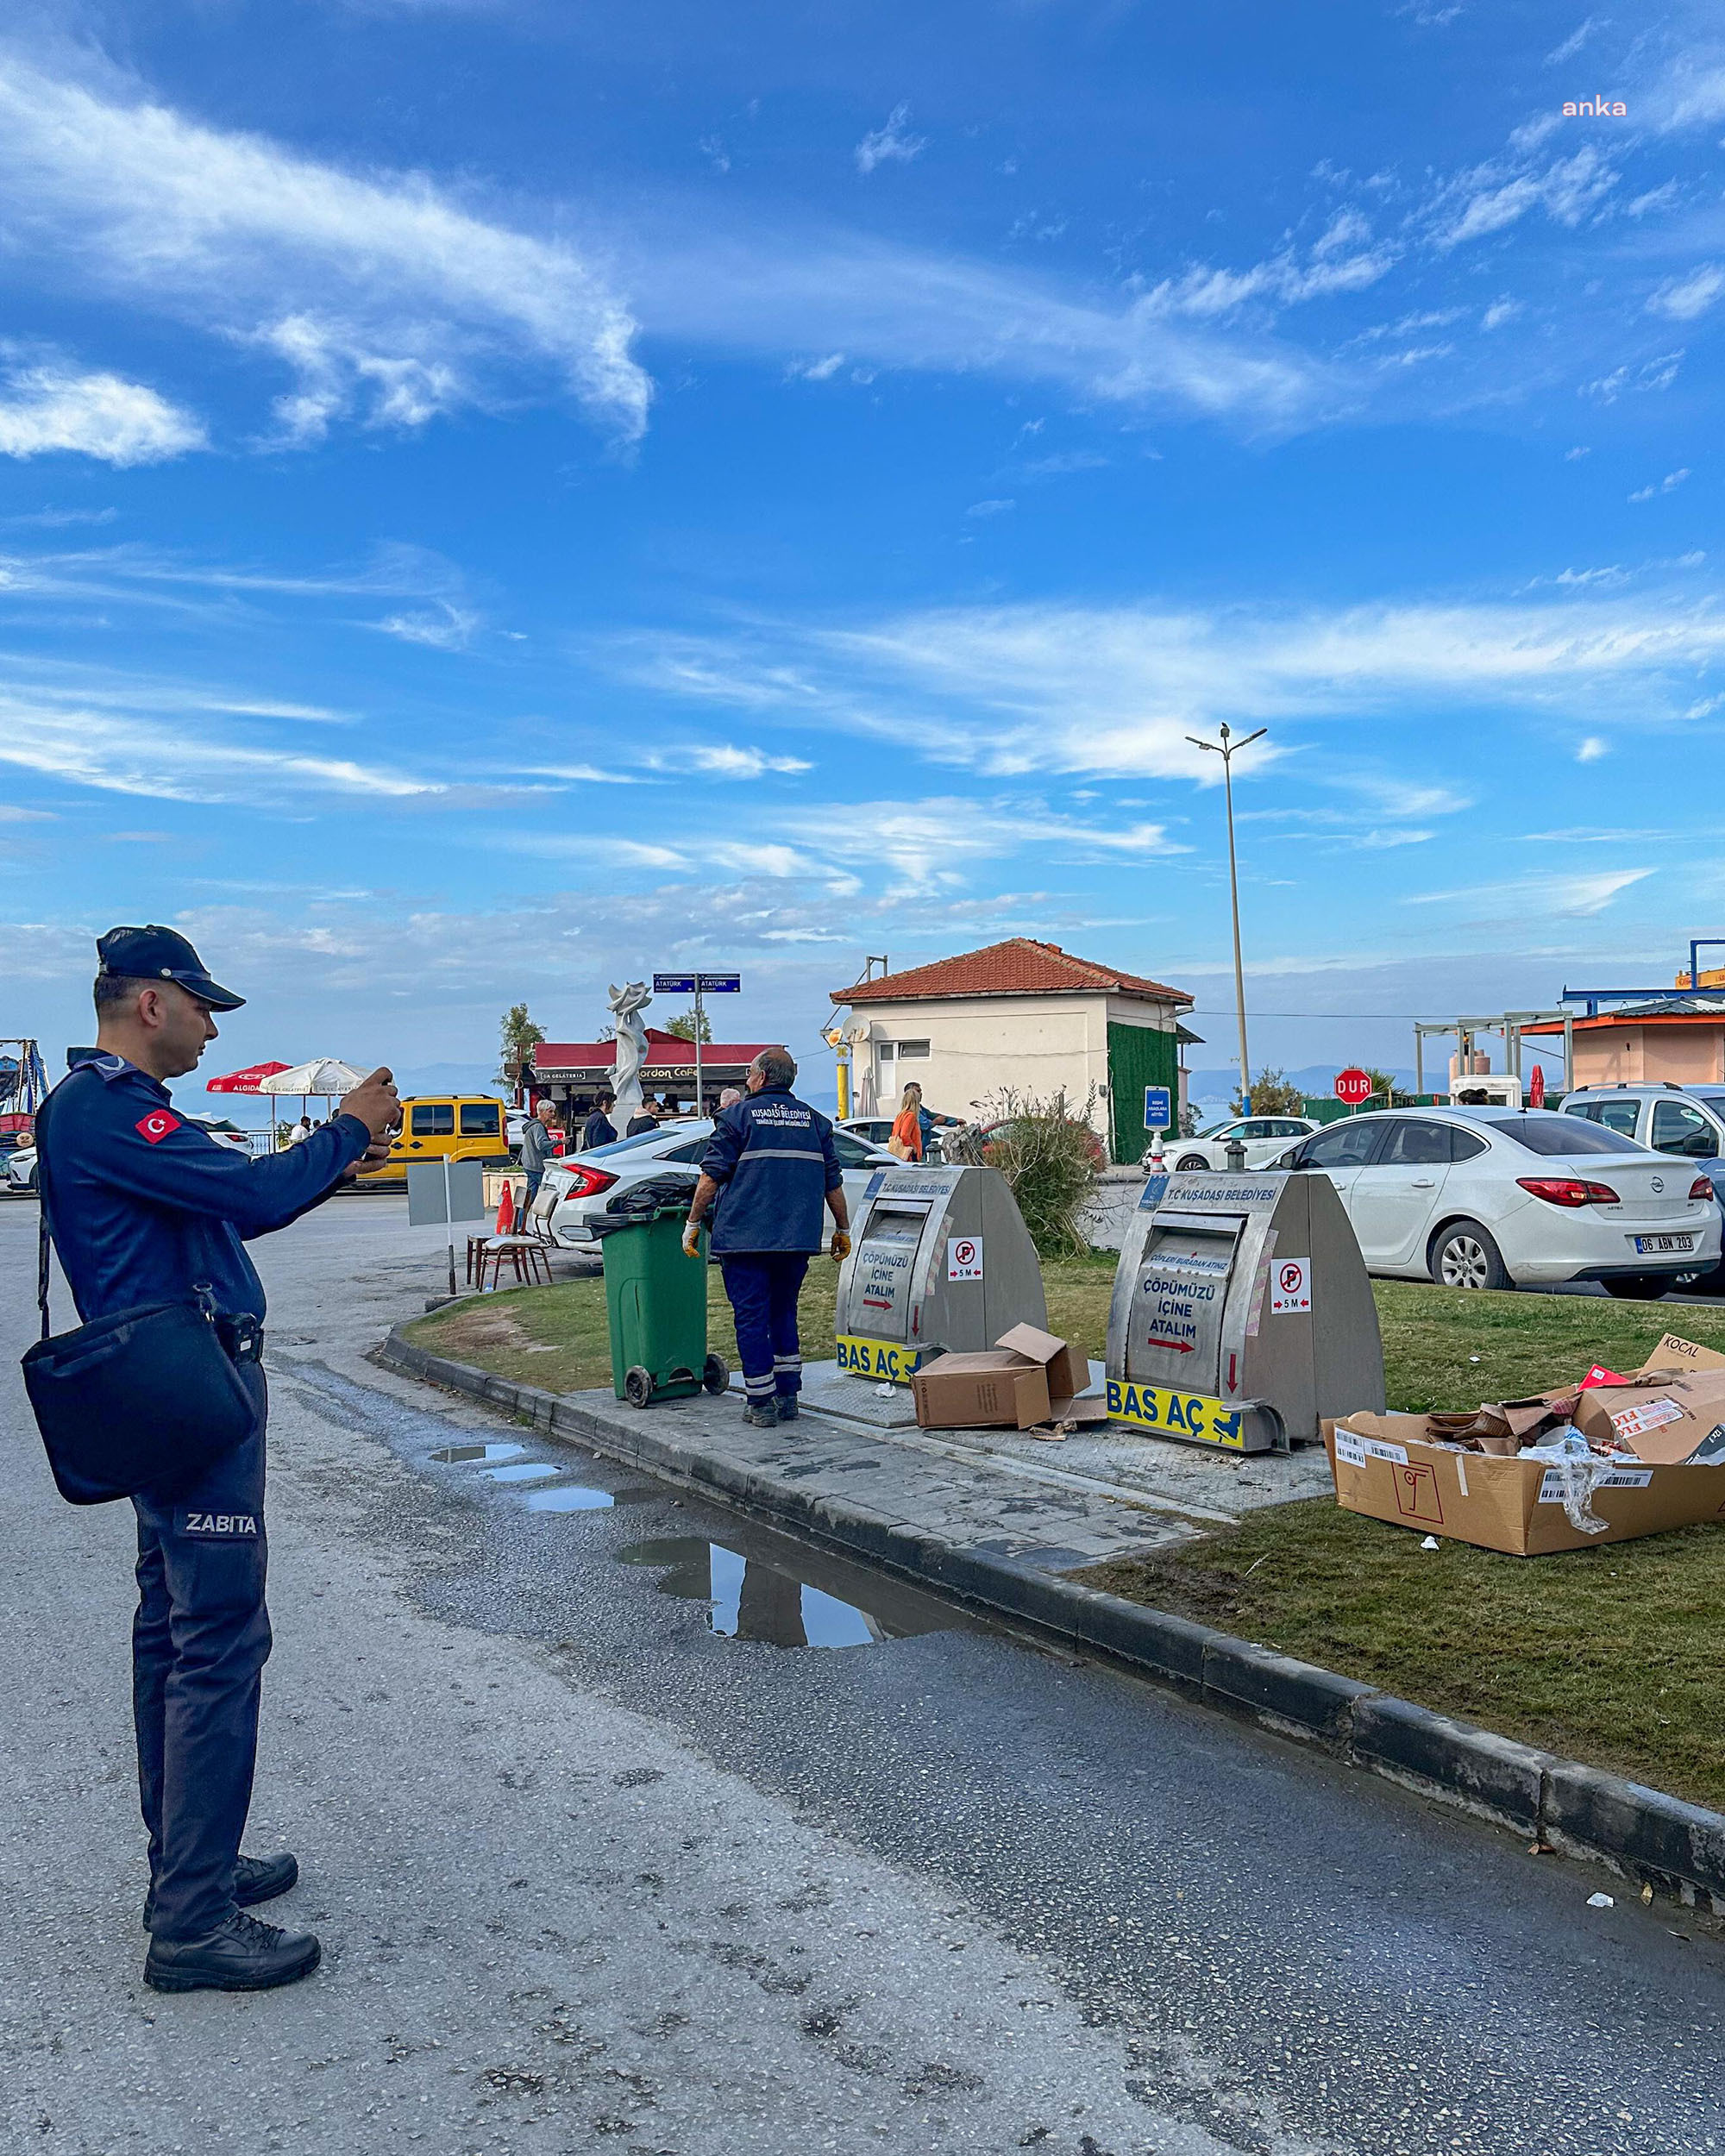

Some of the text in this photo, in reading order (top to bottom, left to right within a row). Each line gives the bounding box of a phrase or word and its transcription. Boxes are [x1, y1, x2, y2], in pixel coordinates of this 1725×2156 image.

[1337, 1079, 1370, 1094] DUR
[751, 1108, 811, 1119] KUŞADASI BELEDİYESİ
[1168, 1187, 1277, 1201] T.C KUŞADASI BELEDİYESİ
[1641, 1236, 1691, 1250] 06 ABN 203
[863, 1251, 908, 1268] ÇÖPÜMÜZÜ
[1151, 1253, 1227, 1270] ÇÖPLERİ BURADAN ATINIZ
[871, 1269, 894, 1282] İÇİNE
[958, 1269, 964, 1277] 5
[864, 1284, 895, 1298] ATALIM
[1144, 1277, 1215, 1301] ÇÖPÜMÜZÜ
[1157, 1299, 1193, 1318] İÇİNE
[1284, 1298, 1298, 1308] 5 M
[1149, 1319, 1196, 1338] ATALIM
[837, 1342, 900, 1378] BAS AÇ
[1107, 1380, 1205, 1438] BAS AÇ
[185, 1513, 257, 1534] ZABITA
